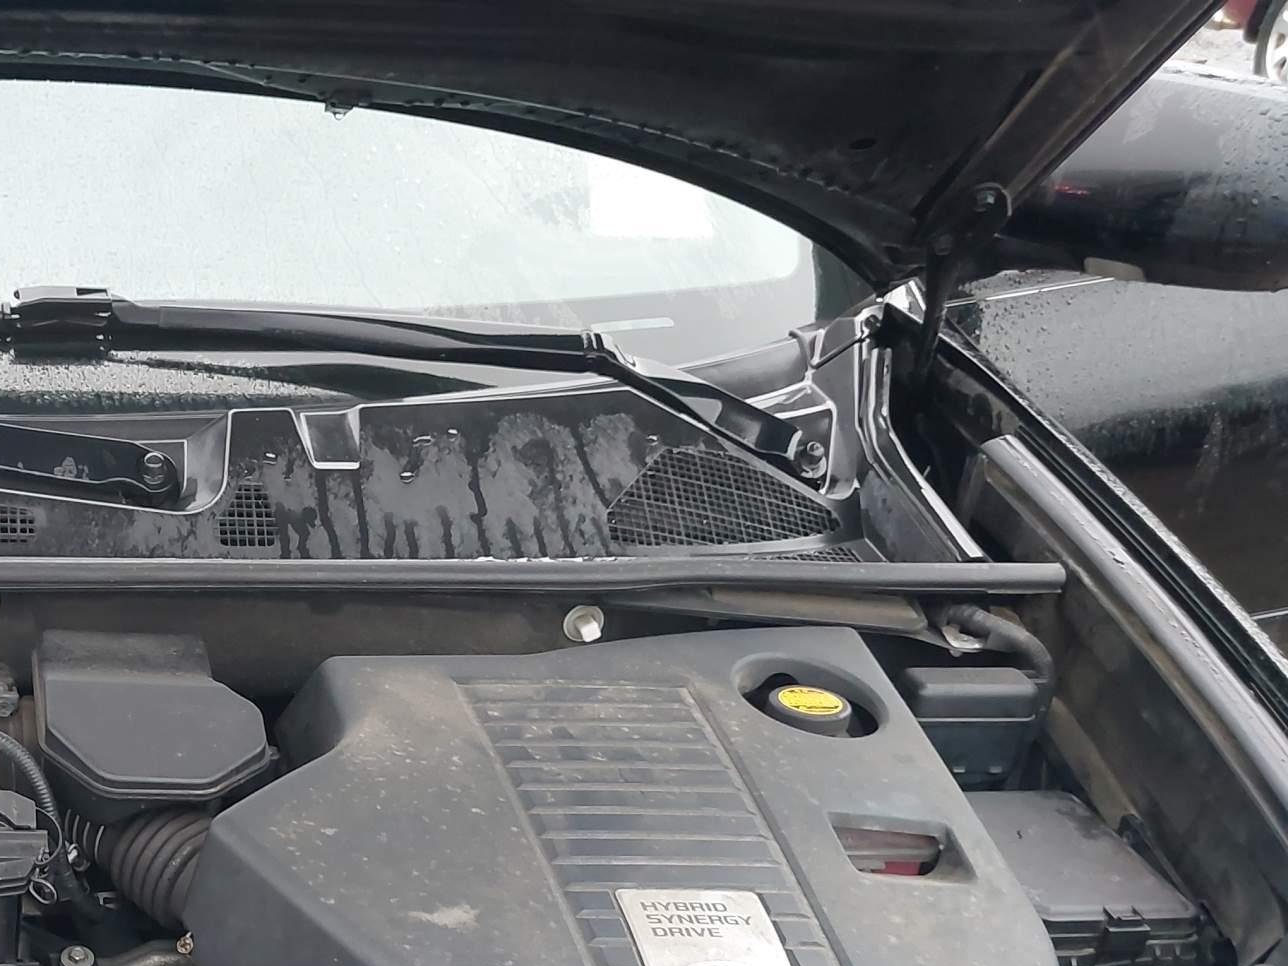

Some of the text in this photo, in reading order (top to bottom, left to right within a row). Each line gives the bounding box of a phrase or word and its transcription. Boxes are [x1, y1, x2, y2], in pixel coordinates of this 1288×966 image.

[640, 901, 727, 912] HYBRID
[646, 914, 752, 926] SYNERGY
[651, 927, 724, 938] DRIVE
